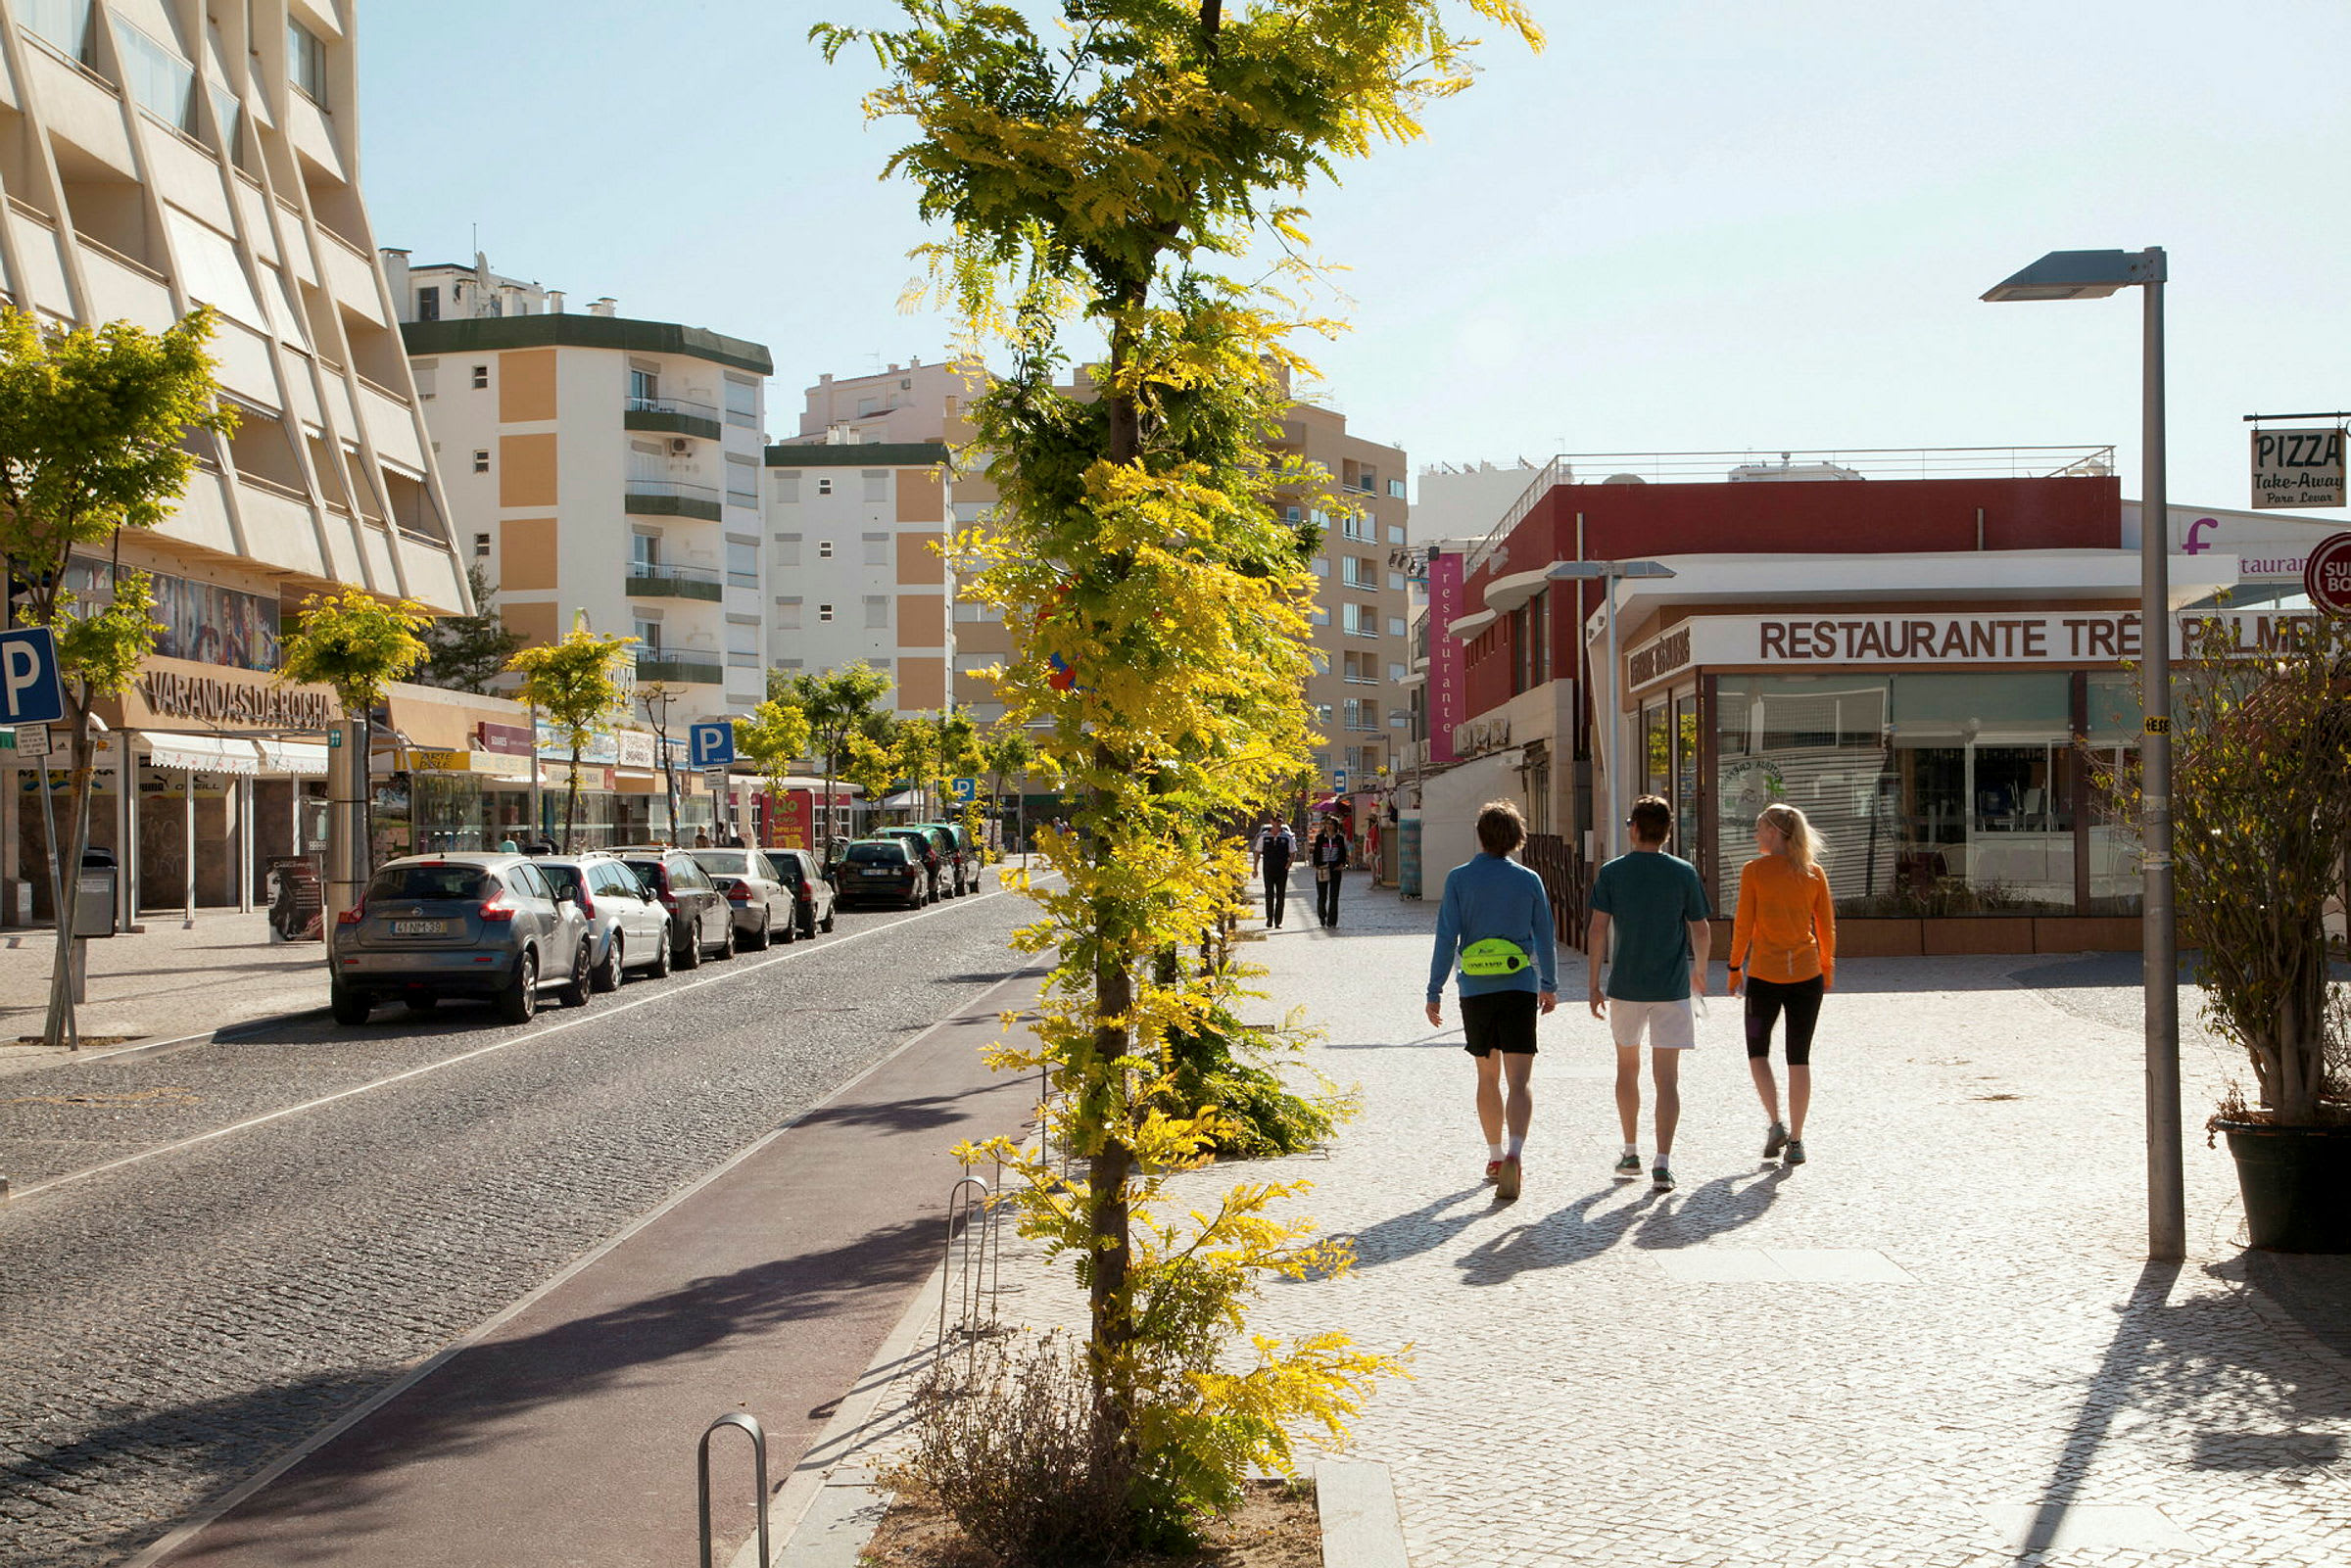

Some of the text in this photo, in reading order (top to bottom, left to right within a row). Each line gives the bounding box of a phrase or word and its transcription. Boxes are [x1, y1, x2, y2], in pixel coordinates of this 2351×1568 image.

[2255, 435, 2341, 467] PIZZA
[2254, 472, 2344, 491] Take-Away
[2267, 492, 2332, 503] Para Levar
[2325, 562, 2351, 577] SU
[1442, 573, 1451, 733] restaurante
[1760, 620, 2047, 658] RESTAURANTE
[2062, 614, 2141, 656] TRÊ
[2, 641, 41, 716] P
[147, 671, 249, 723] VARANDAS
[251, 686, 274, 727] DA
[699, 728, 724, 762] P
